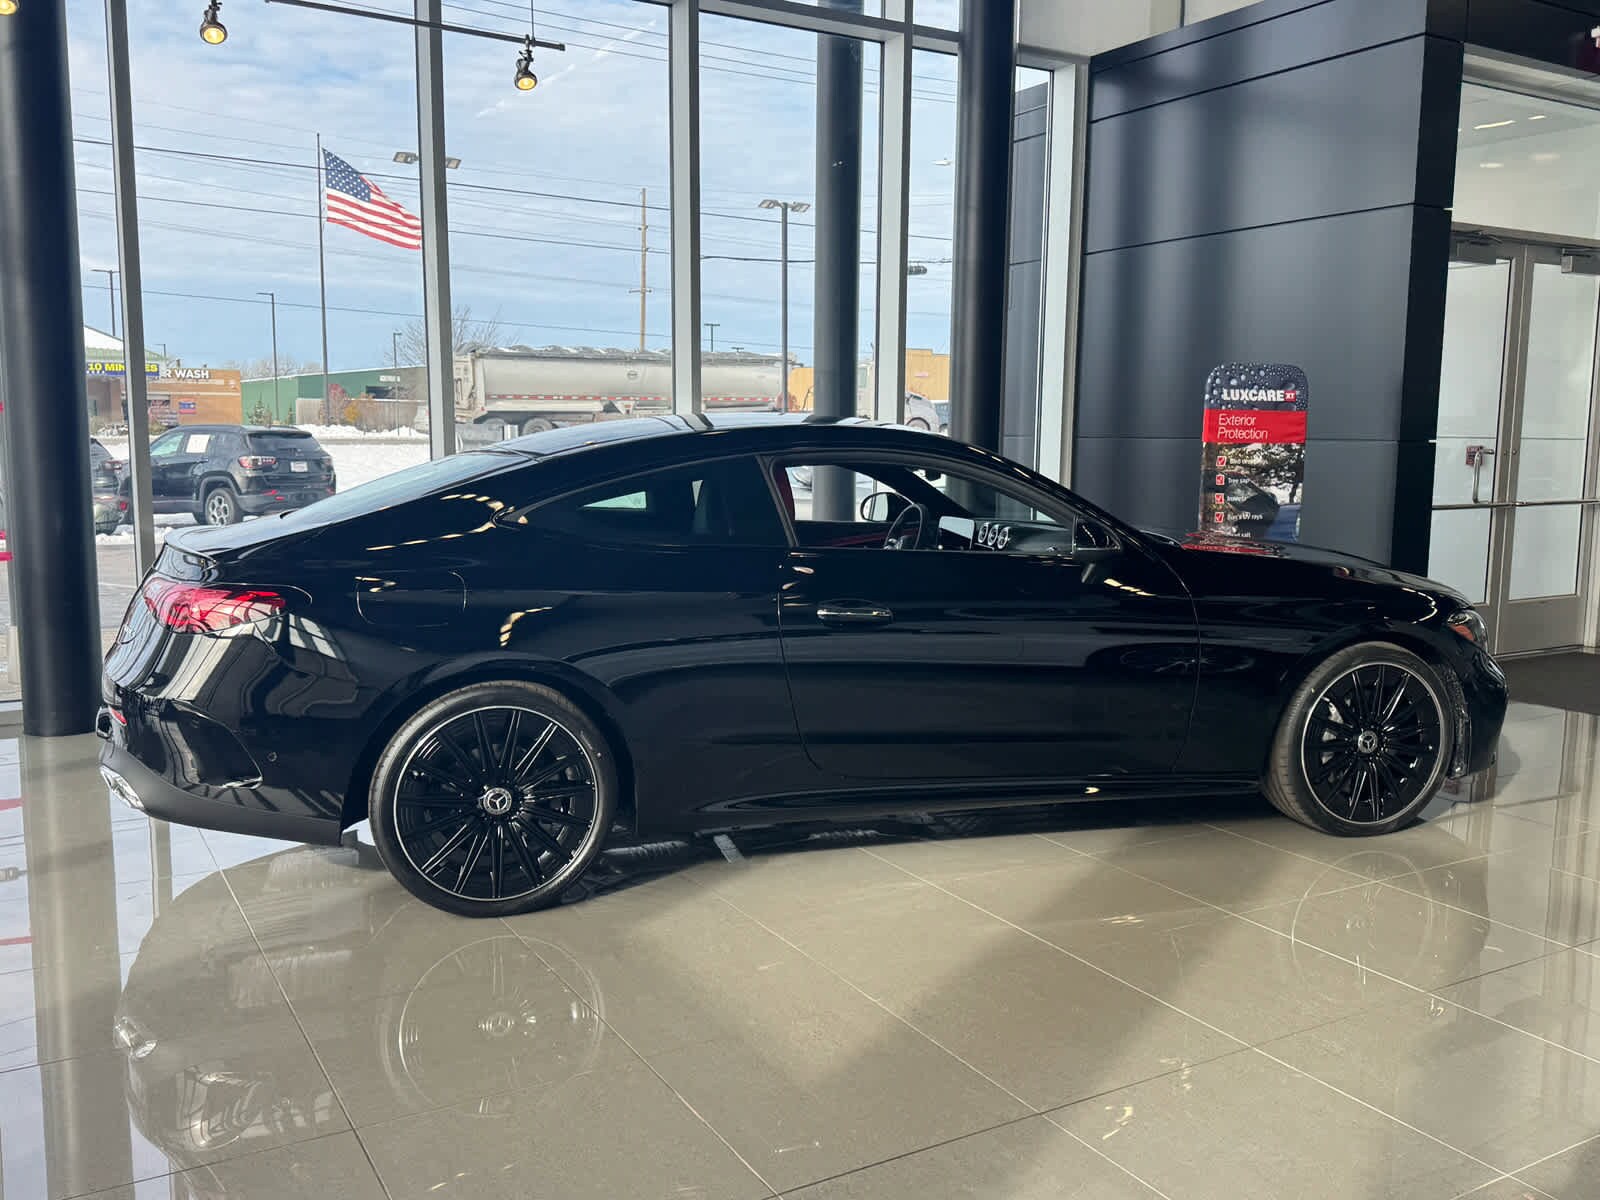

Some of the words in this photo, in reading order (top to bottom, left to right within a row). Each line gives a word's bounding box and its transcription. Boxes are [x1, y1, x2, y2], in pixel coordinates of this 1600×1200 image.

[175, 369, 209, 379] WASH
[1223, 389, 1284, 401] LUXCARE
[1218, 413, 1256, 426] Exterior
[1217, 427, 1268, 439] Protection
